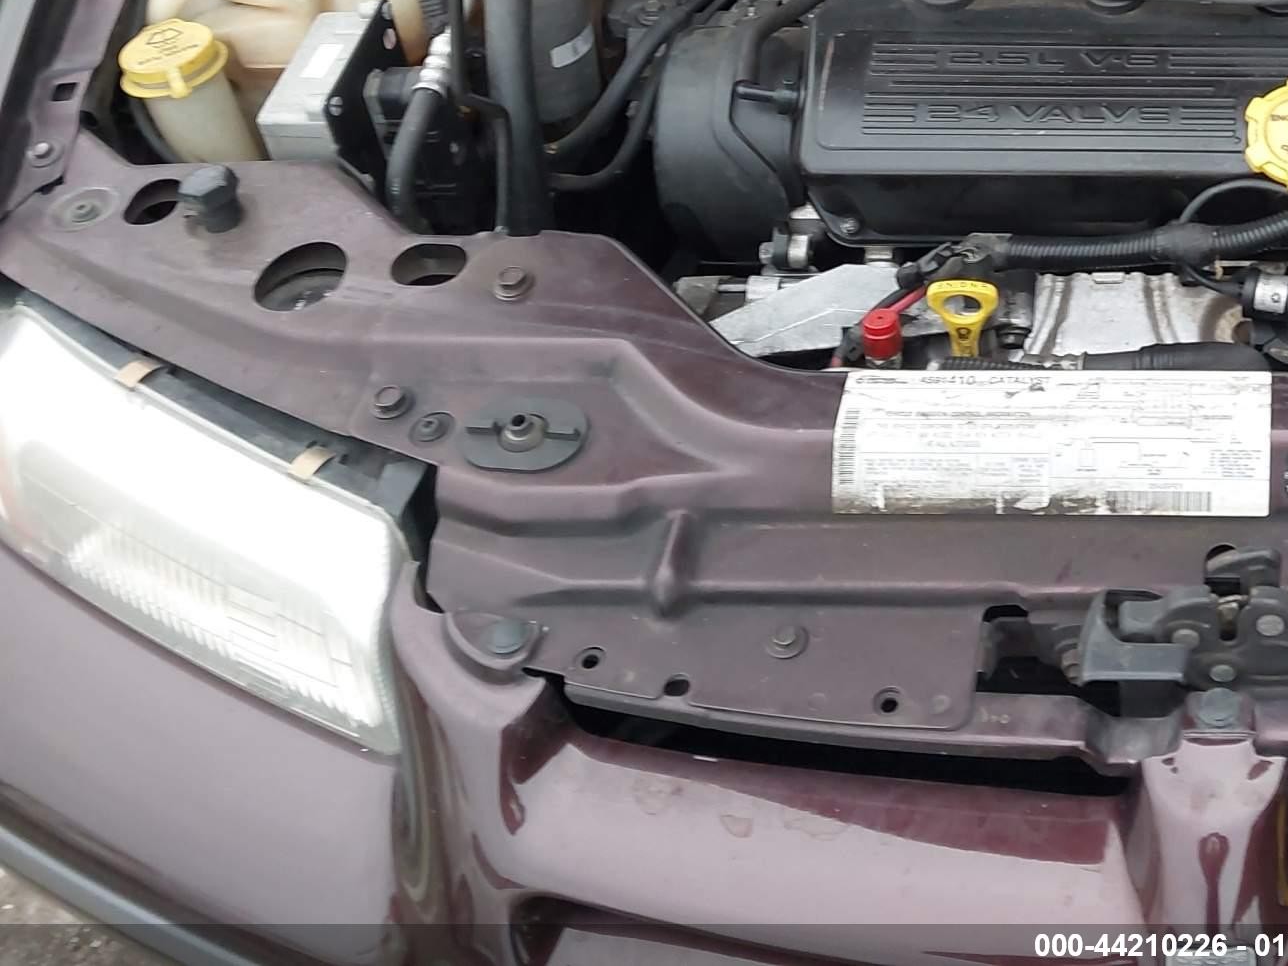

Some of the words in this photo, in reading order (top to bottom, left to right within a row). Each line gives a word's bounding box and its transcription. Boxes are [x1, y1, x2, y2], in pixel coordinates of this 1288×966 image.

[947, 48, 1062, 69] 2.5L
[926, 103, 999, 123] 24
[1008, 104, 1171, 124] VALVE
